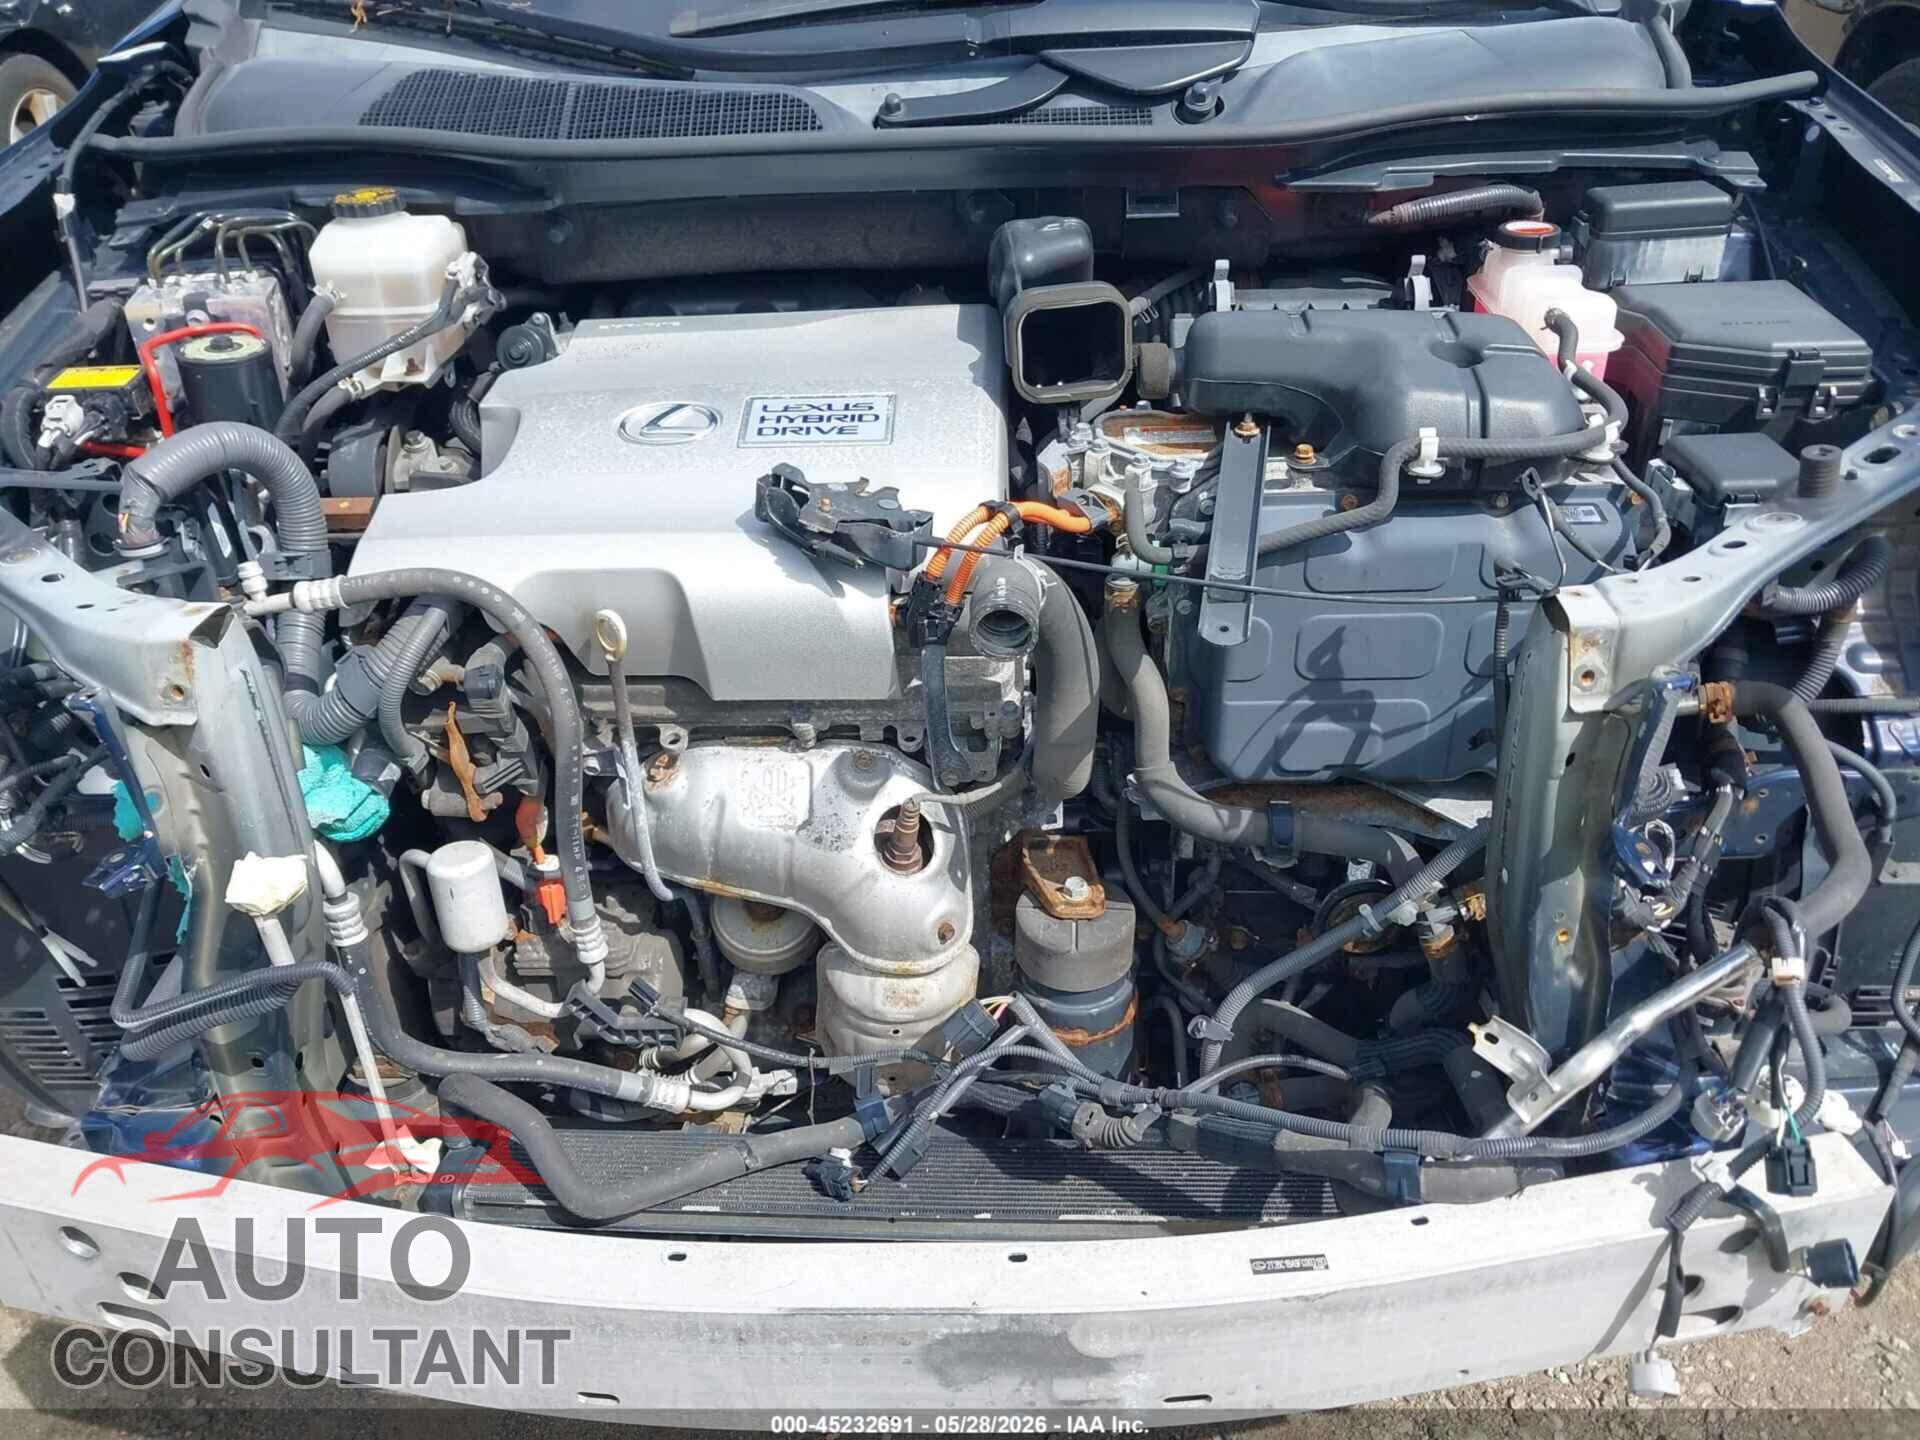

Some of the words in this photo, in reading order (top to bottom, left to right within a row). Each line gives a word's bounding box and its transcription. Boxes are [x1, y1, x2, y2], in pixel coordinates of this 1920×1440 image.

[762, 402, 875, 413] LEXUS
[759, 413, 880, 424] HYBRID
[757, 425, 859, 436] DRIVE
